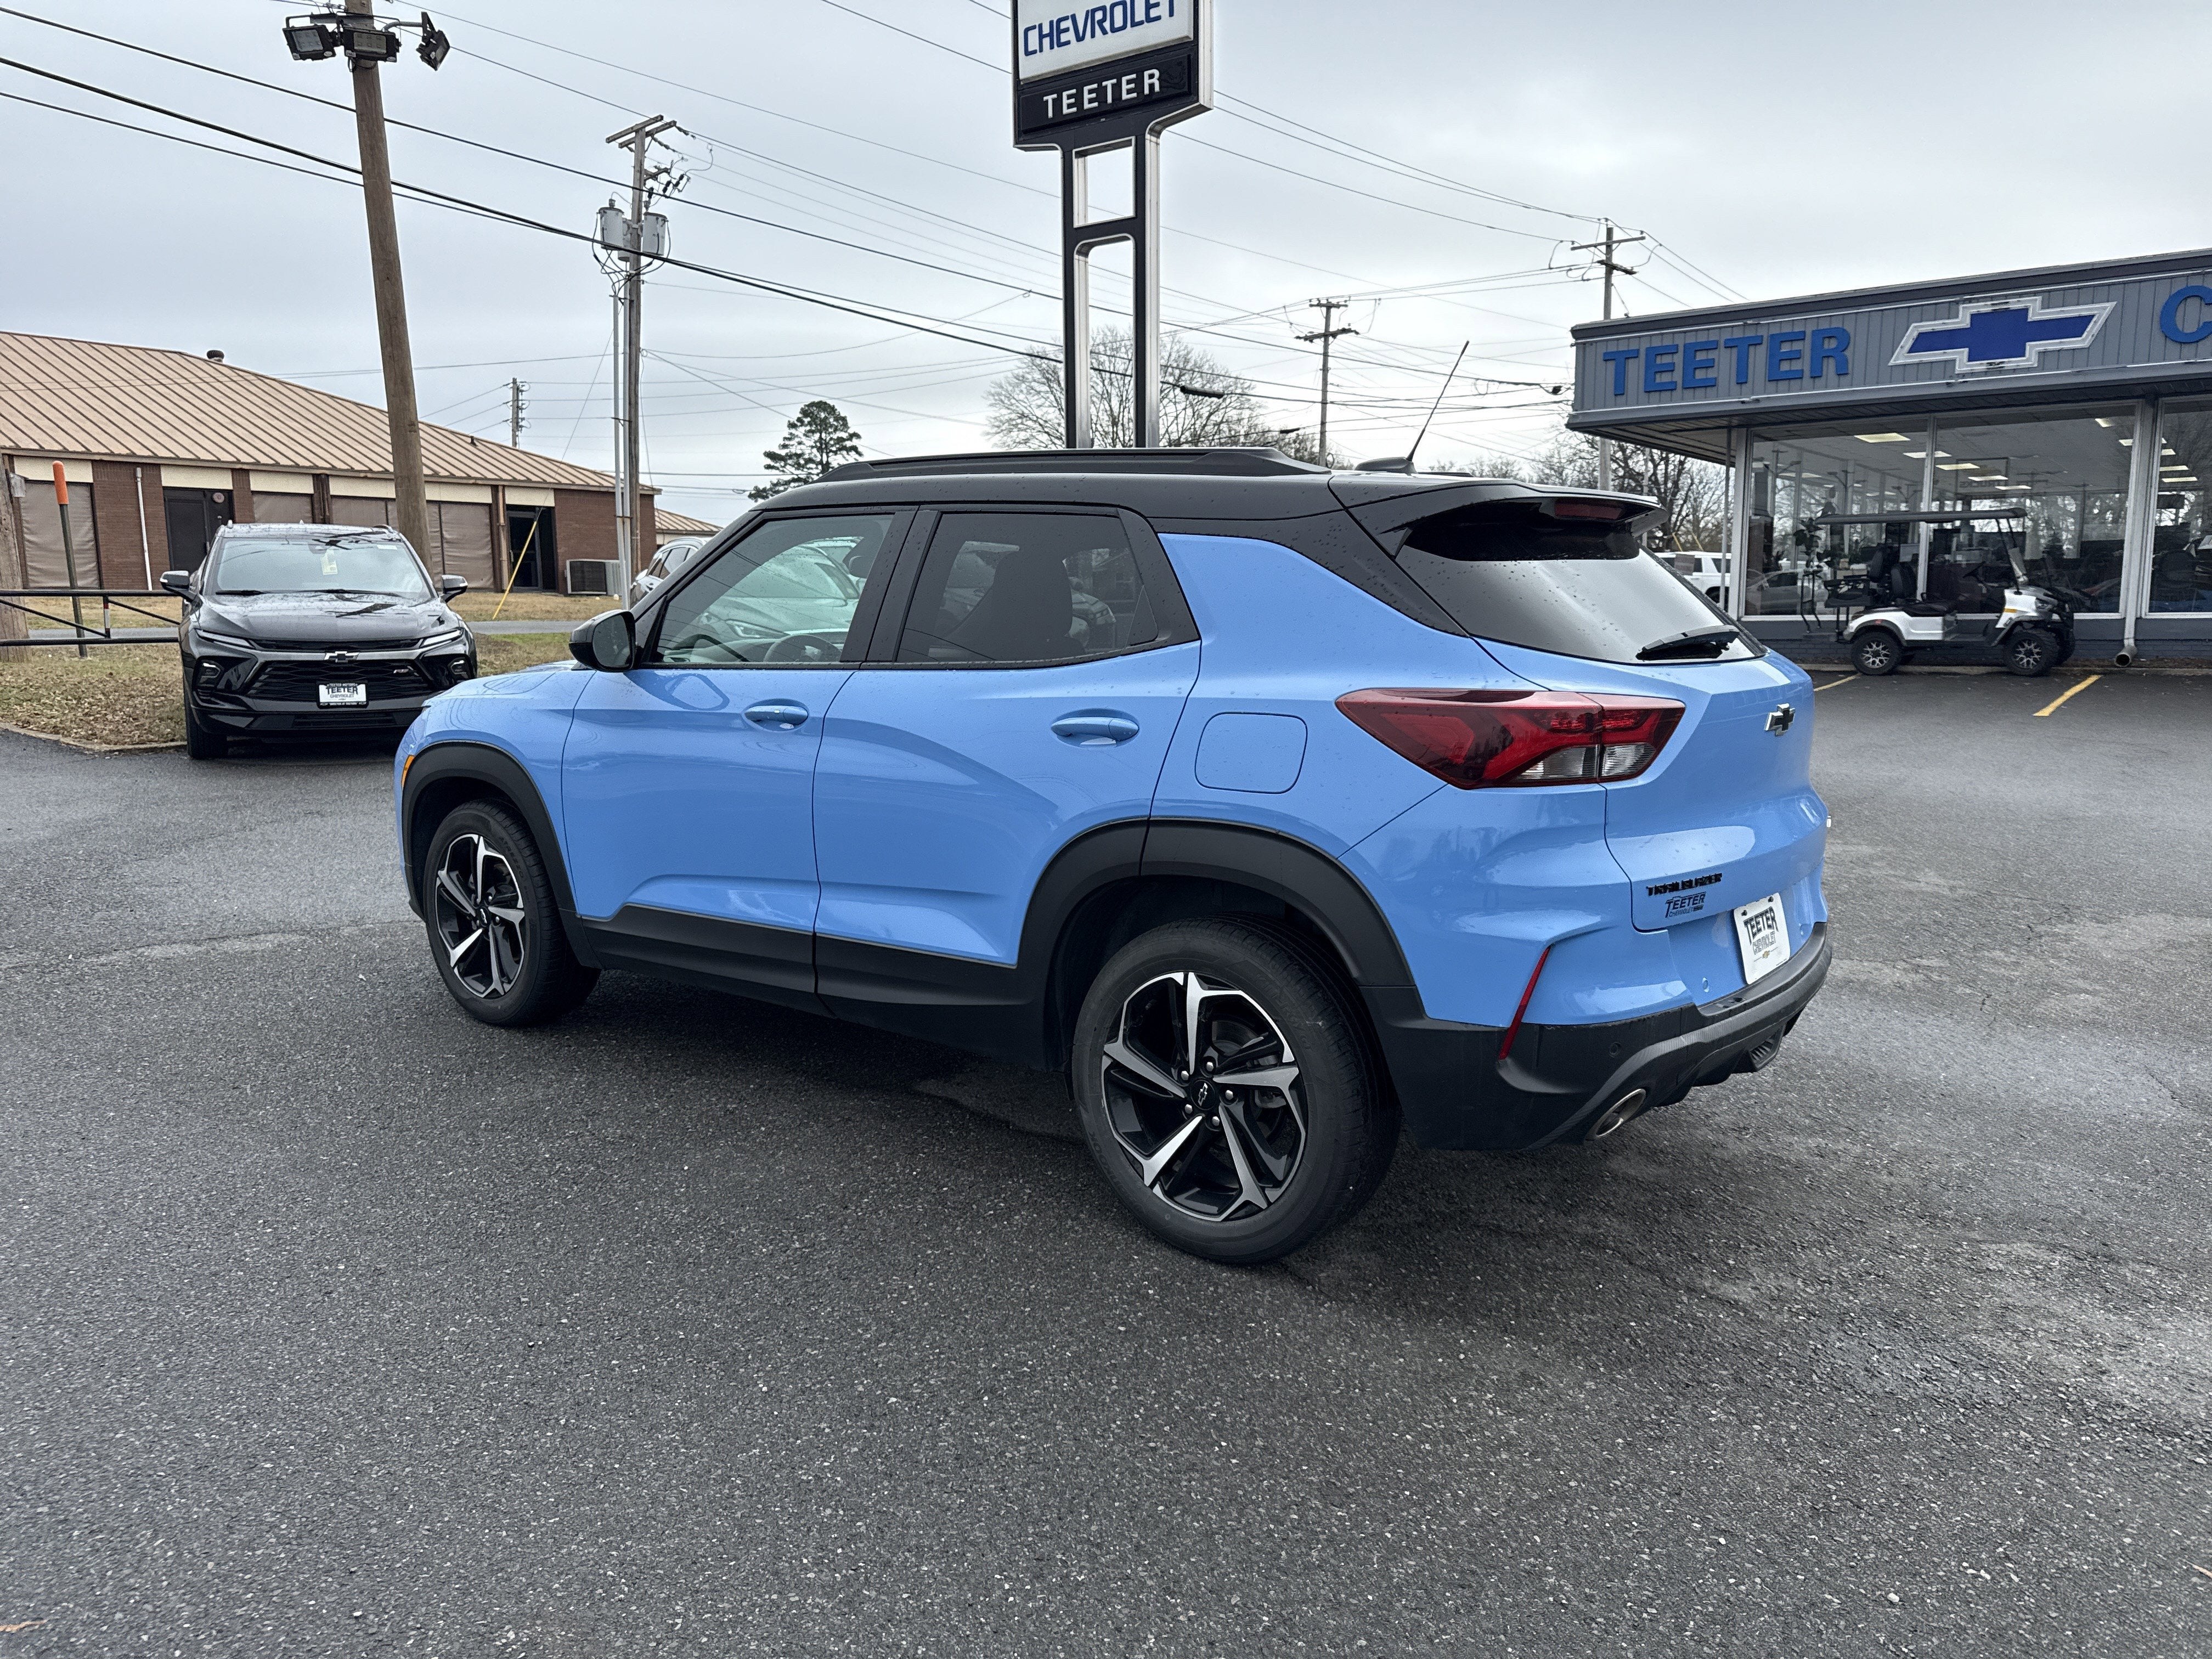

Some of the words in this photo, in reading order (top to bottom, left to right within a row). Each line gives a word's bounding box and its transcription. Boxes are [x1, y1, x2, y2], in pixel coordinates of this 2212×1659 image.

[1043, 69, 1160, 119] TEETER
[1603, 327, 1850, 396] TEETER
[325, 685, 358, 695] TEETER
[1665, 892, 1706, 918] TEETER
[1743, 906, 1779, 945] TEETER
